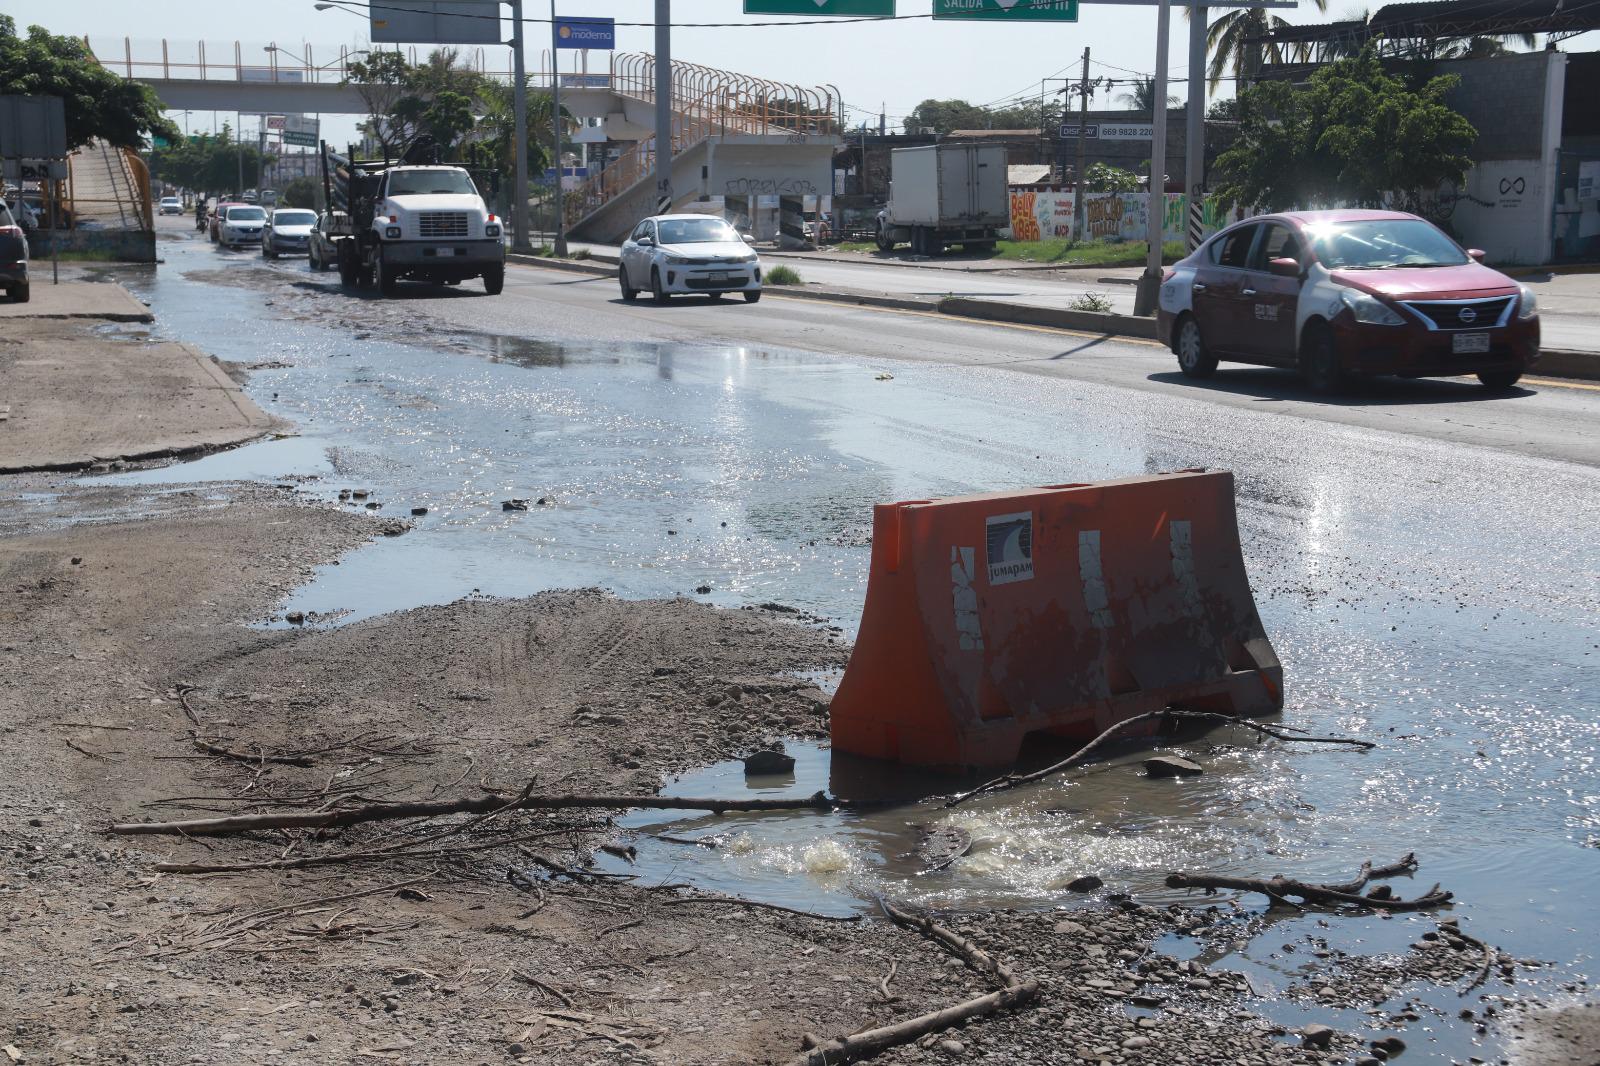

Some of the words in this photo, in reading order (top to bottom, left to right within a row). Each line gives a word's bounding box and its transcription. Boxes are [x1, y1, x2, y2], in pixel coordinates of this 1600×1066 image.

[571, 30, 611, 40] moderna
[1102, 128, 1117, 136] 669
[1119, 128, 1138, 136] 9828
